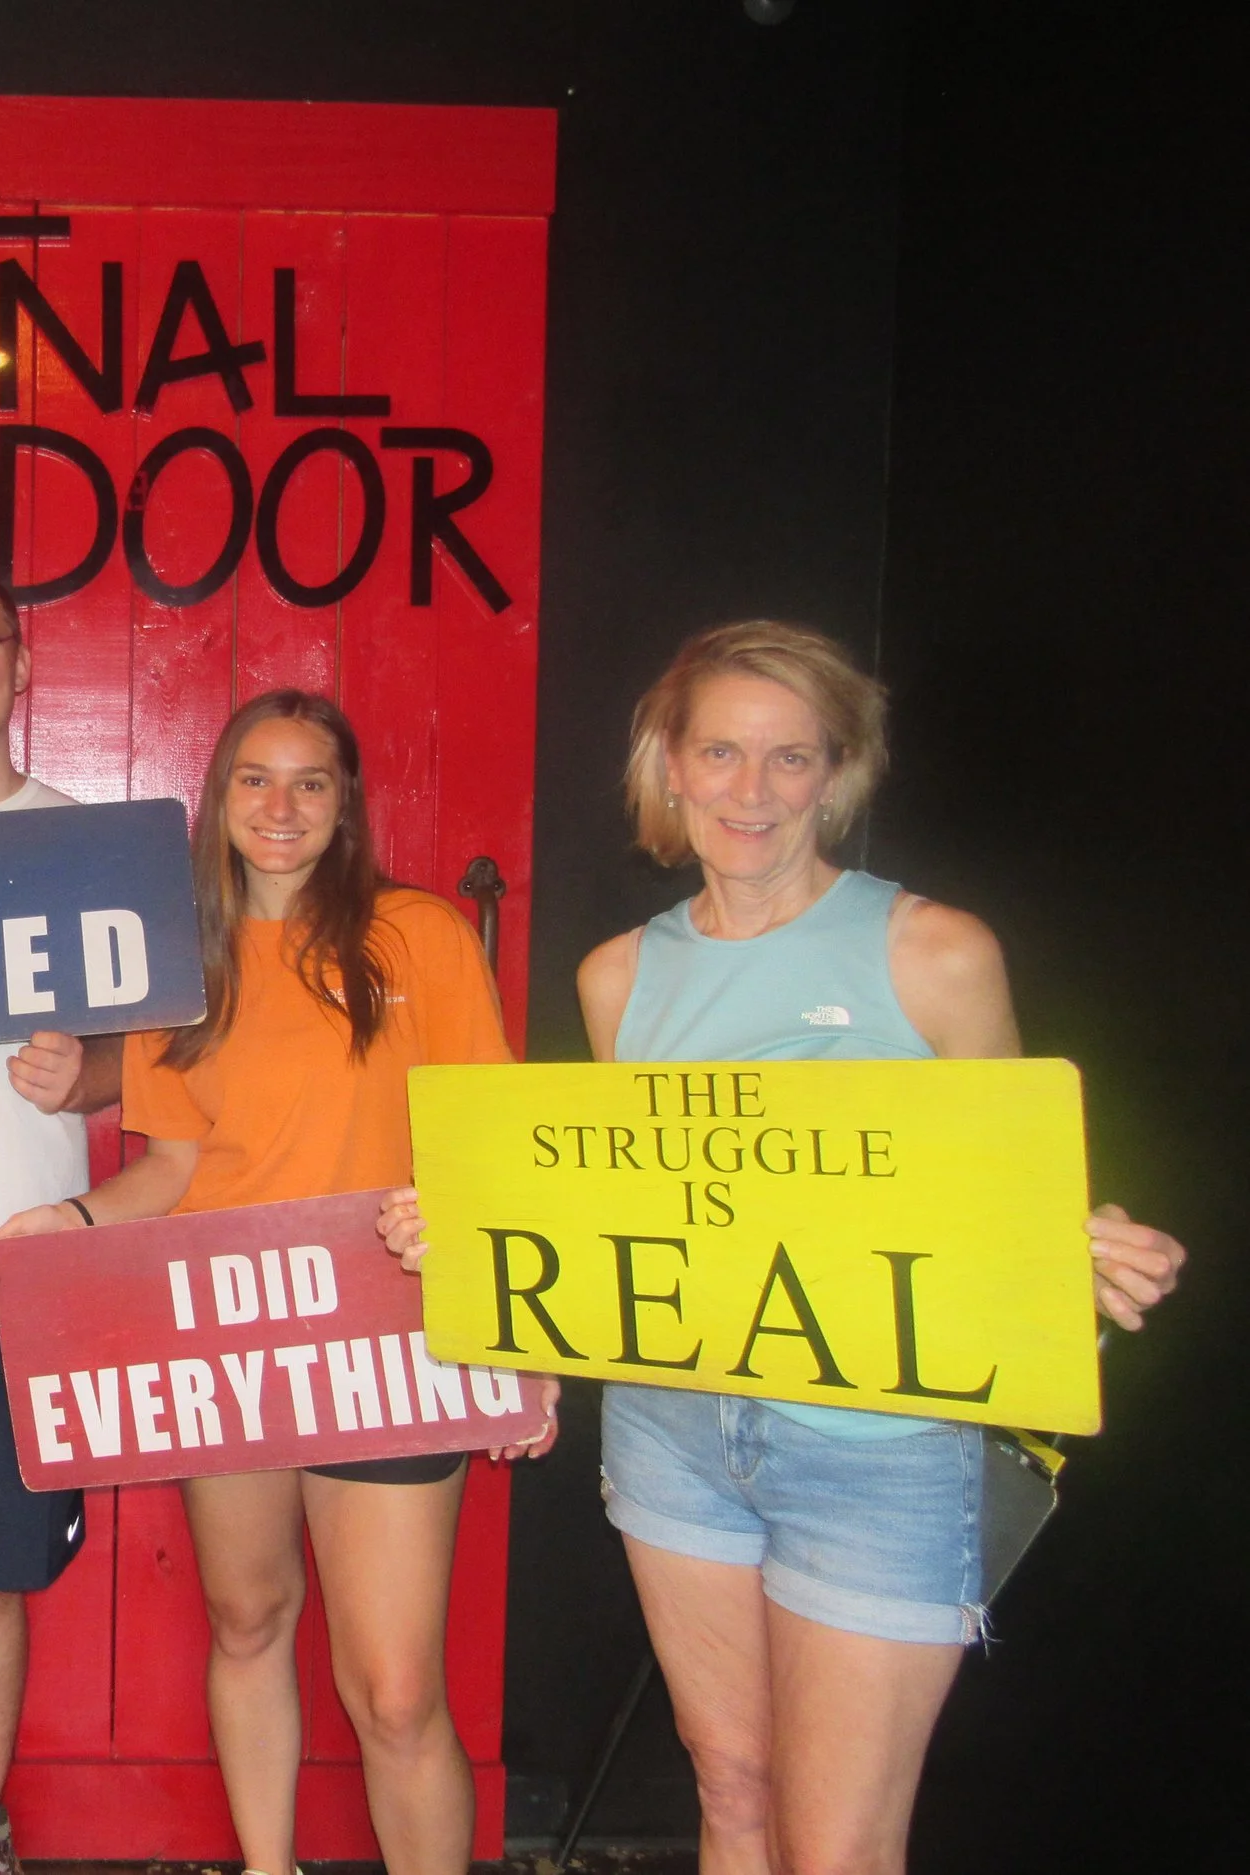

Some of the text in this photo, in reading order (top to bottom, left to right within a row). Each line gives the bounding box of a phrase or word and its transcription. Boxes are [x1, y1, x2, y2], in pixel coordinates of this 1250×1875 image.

[634, 1072, 766, 1118] THE
[532, 1125, 898, 1178] STRUGGLE
[681, 1181, 735, 1228] IS
[167, 1245, 338, 1330] I DID
[477, 1226, 998, 1405] REAL
